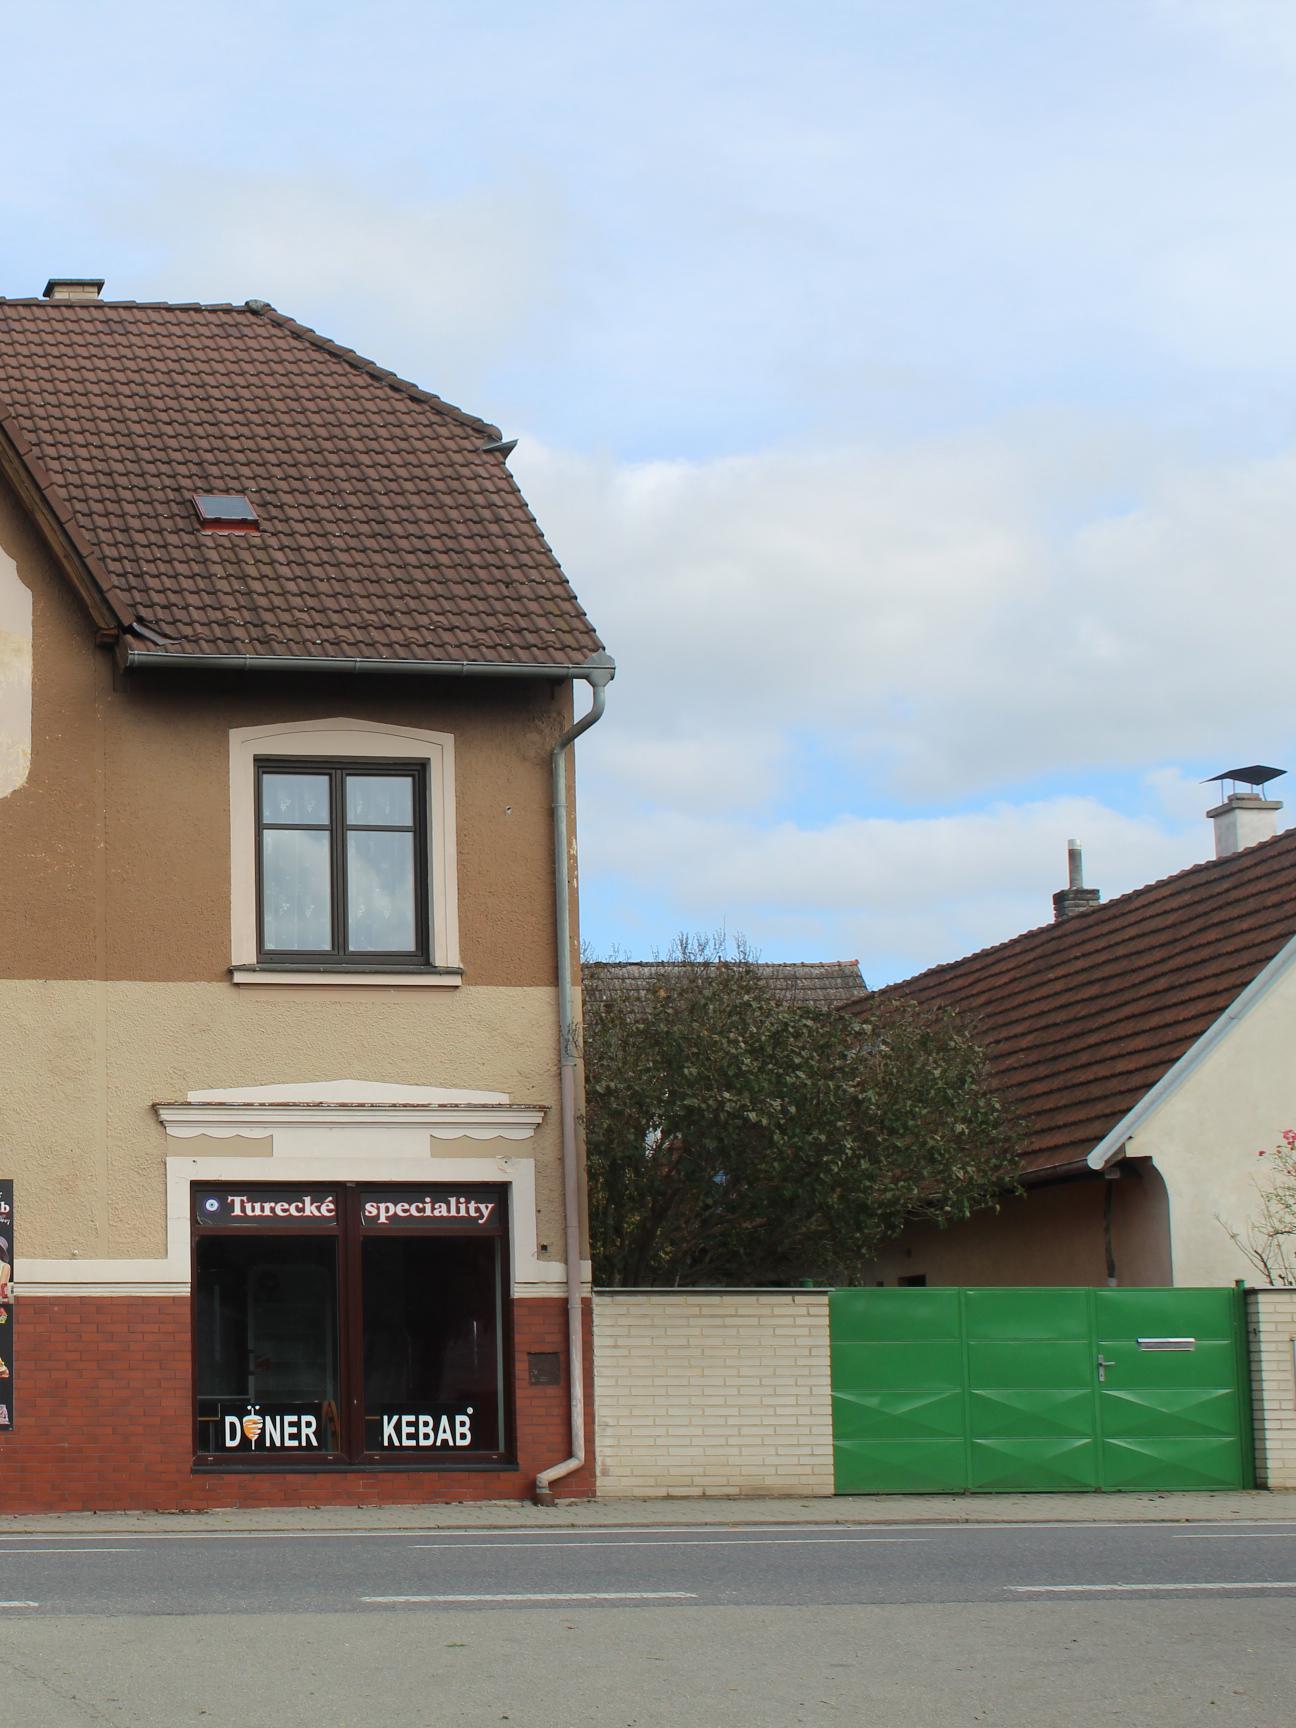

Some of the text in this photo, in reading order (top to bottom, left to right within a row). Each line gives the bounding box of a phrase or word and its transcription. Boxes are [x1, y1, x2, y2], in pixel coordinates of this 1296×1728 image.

[227, 1195, 495, 1224] Turecké speciality
[383, 1414, 472, 1446] KEBAB
